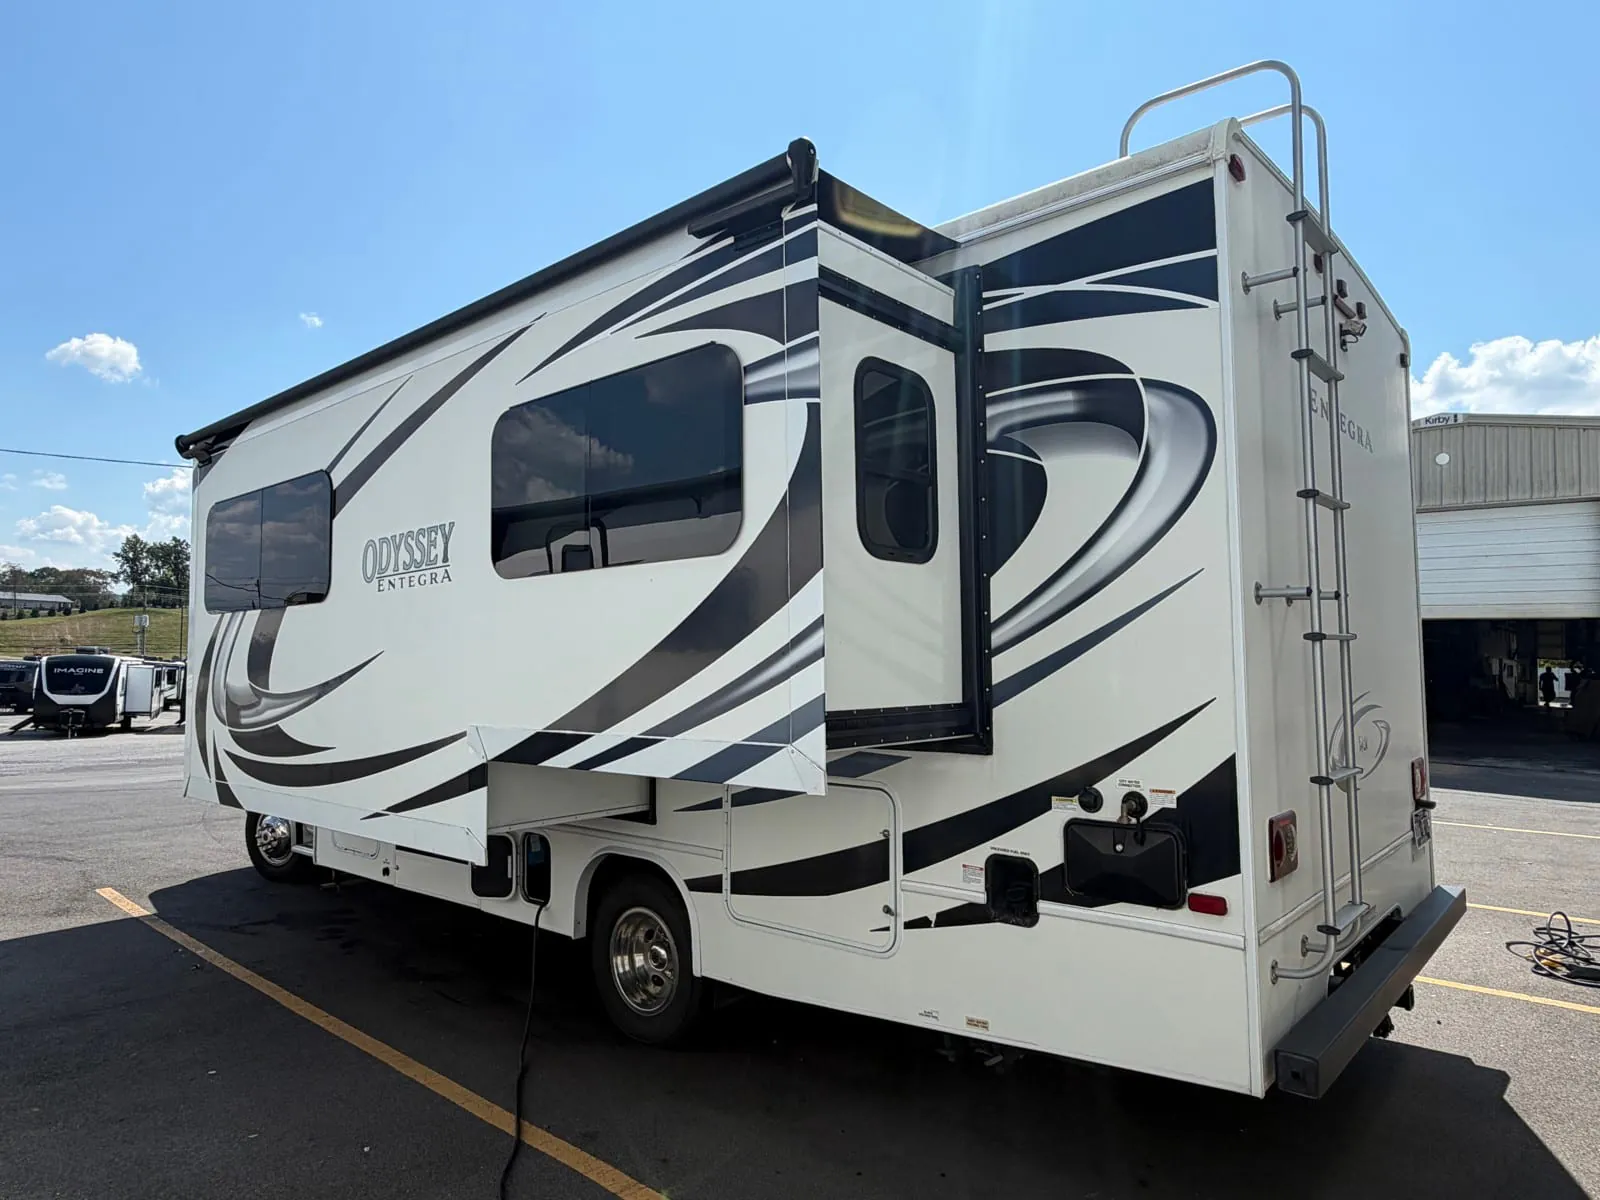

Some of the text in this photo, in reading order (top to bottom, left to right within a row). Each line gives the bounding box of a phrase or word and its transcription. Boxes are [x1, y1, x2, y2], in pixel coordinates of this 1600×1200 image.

[1310, 388, 1374, 454] ENEGRA
[1425, 415, 1450, 425] Kirby
[362, 521, 455, 584] ODYSSEY
[377, 568, 453, 593] ENTEGRA
[53, 667, 105, 675] IMAGINE
